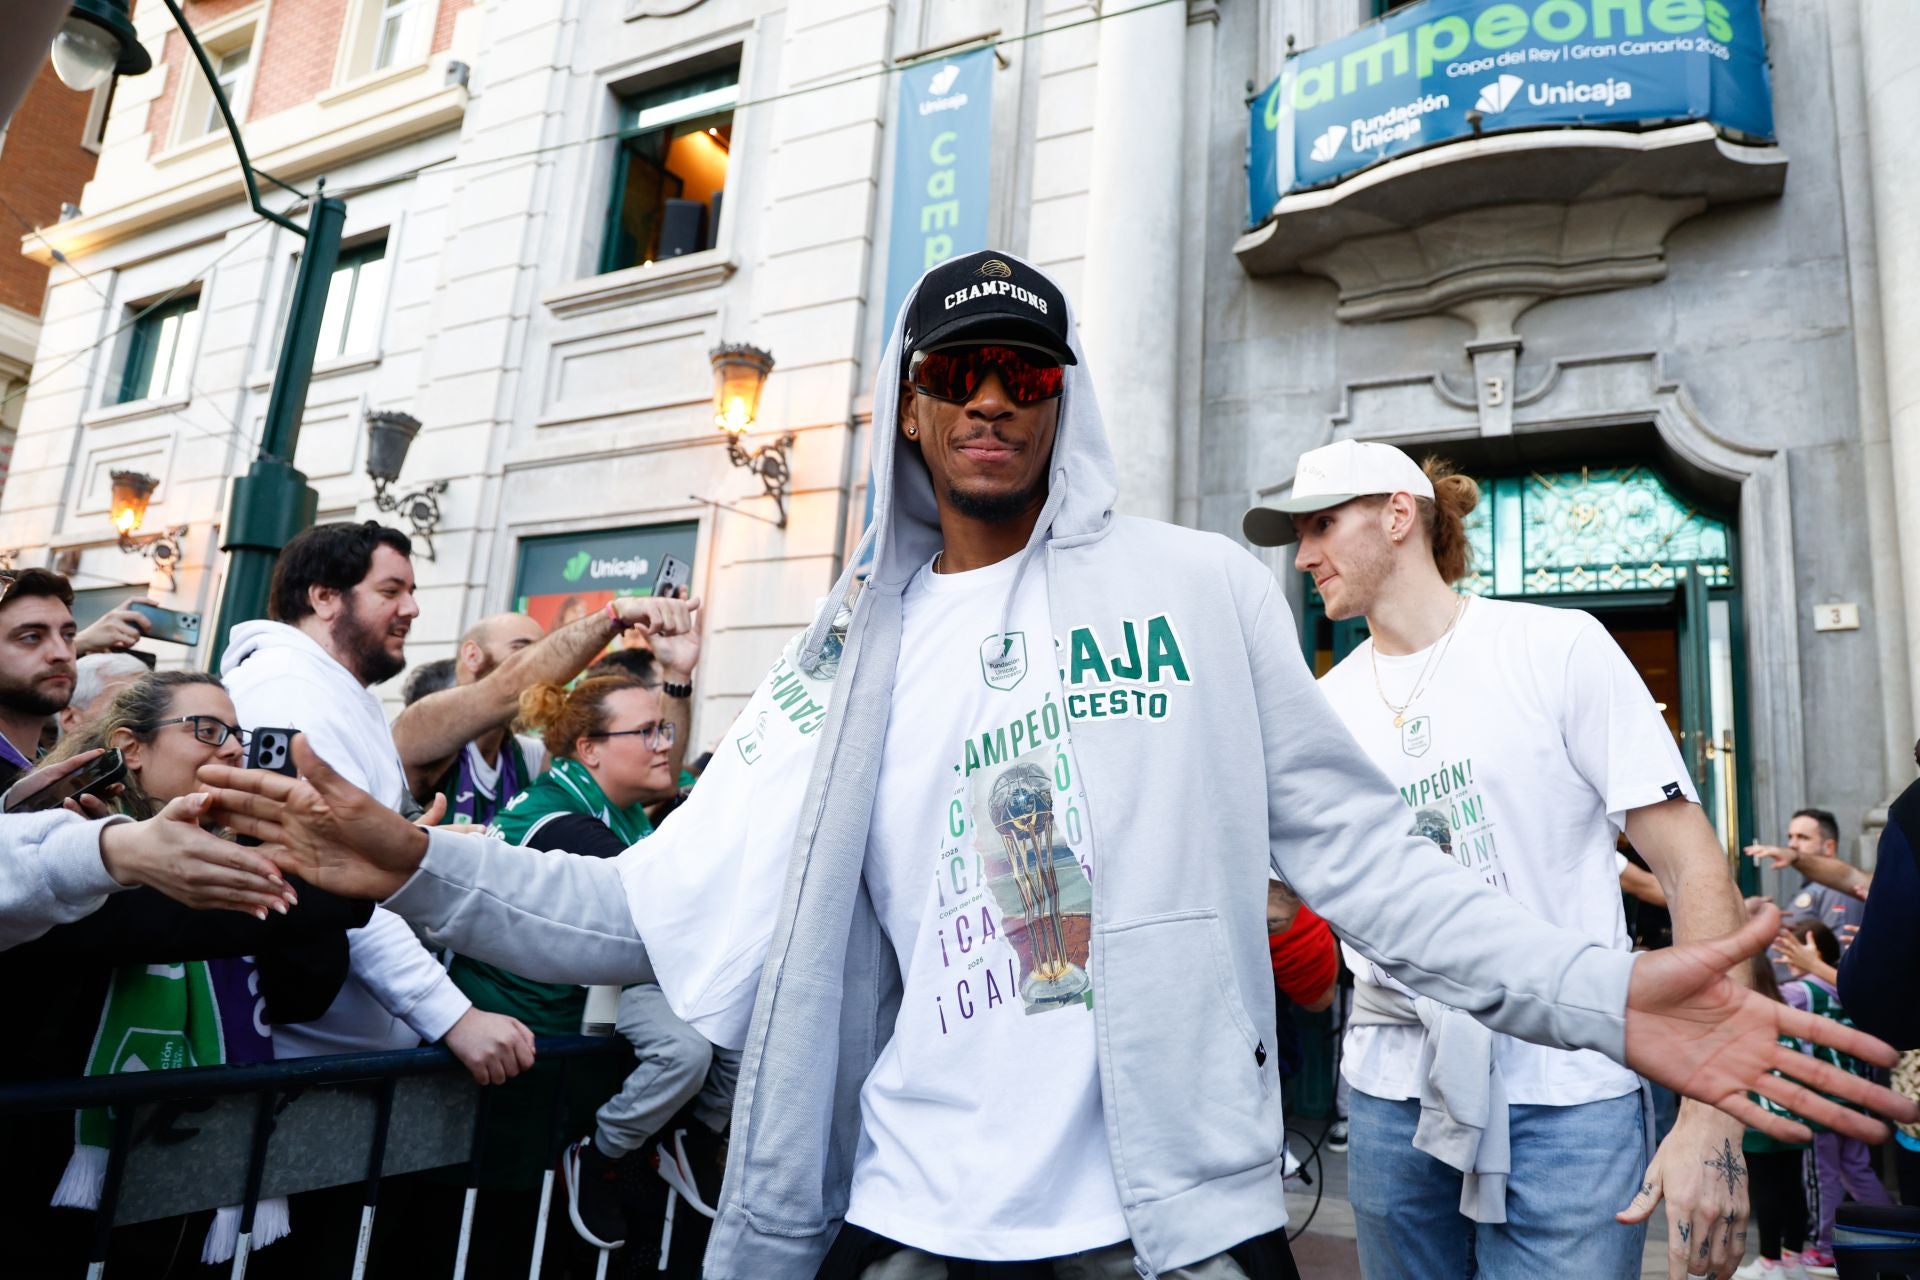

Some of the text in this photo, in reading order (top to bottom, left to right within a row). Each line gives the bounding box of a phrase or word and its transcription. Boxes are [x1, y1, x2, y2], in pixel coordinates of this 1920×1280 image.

[1446, 57, 1494, 77] Copa
[1497, 48, 1526, 65] del
[1529, 46, 1559, 63] Rey
[1571, 43, 1616, 59] Gran
[1619, 37, 1693, 55] Canaria
[919, 92, 968, 116] Unicaja
[1528, 78, 1631, 107] Unicaja
[1351, 94, 1450, 134] Fundación
[1352, 118, 1422, 153] Unicaja
[944, 280, 1048, 315] CHAMPIONS
[1486, 378, 1504, 407] 3
[590, 556, 648, 580] Unicaja
[1830, 608, 1841, 624] 3
[1055, 615, 1190, 684] AJA
[1068, 689, 1167, 718] CESTO
[956, 692, 1070, 778] AMPEÓ
